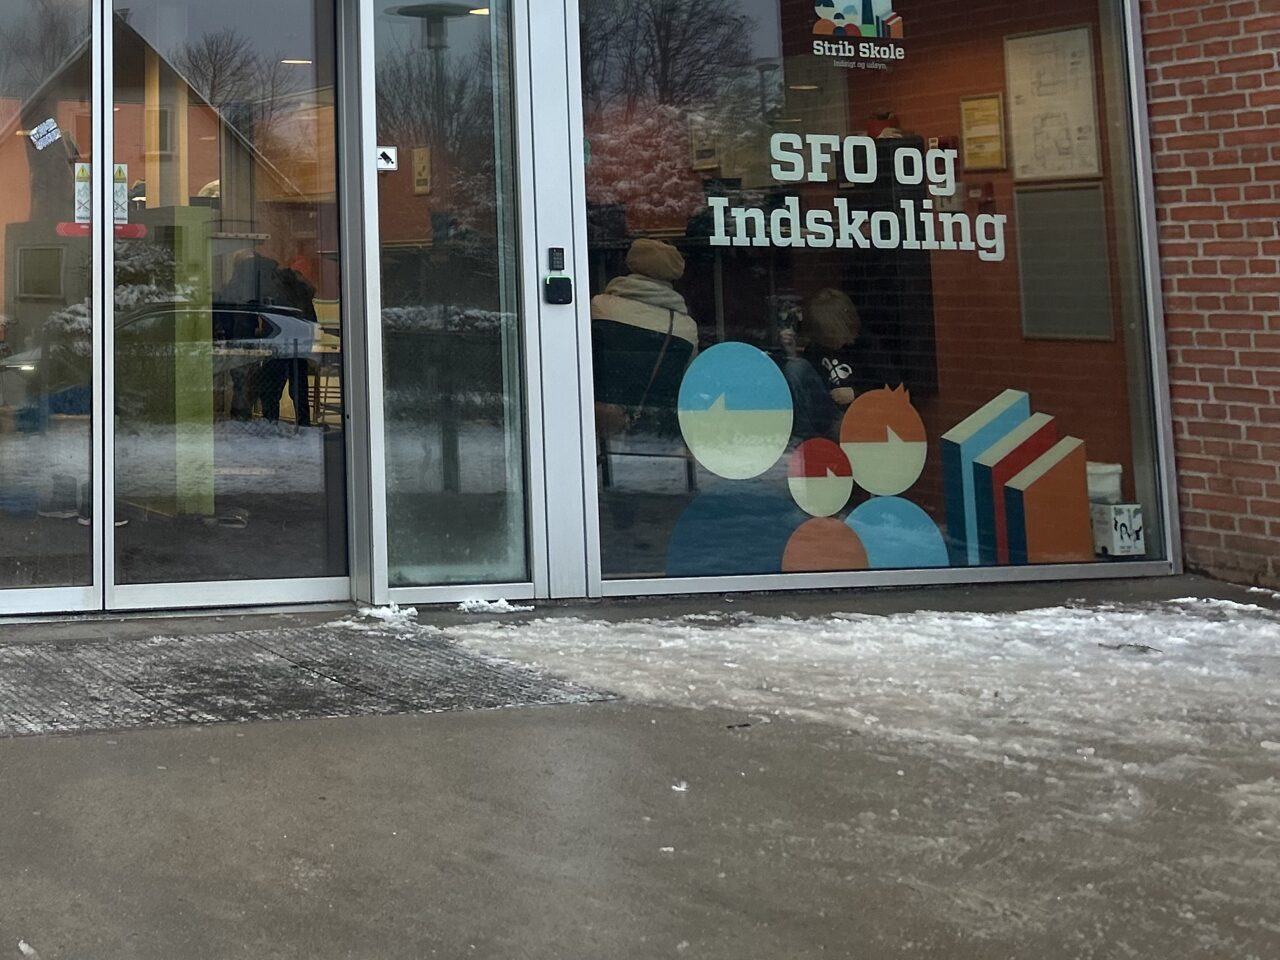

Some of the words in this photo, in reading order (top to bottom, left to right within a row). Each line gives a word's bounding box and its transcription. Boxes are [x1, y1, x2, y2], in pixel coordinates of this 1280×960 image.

[812, 40, 855, 57] Strib
[859, 42, 905, 60] Skole
[770, 132, 877, 183] SFO
[894, 147, 958, 196] og
[708, 196, 1007, 262] Indskoling
